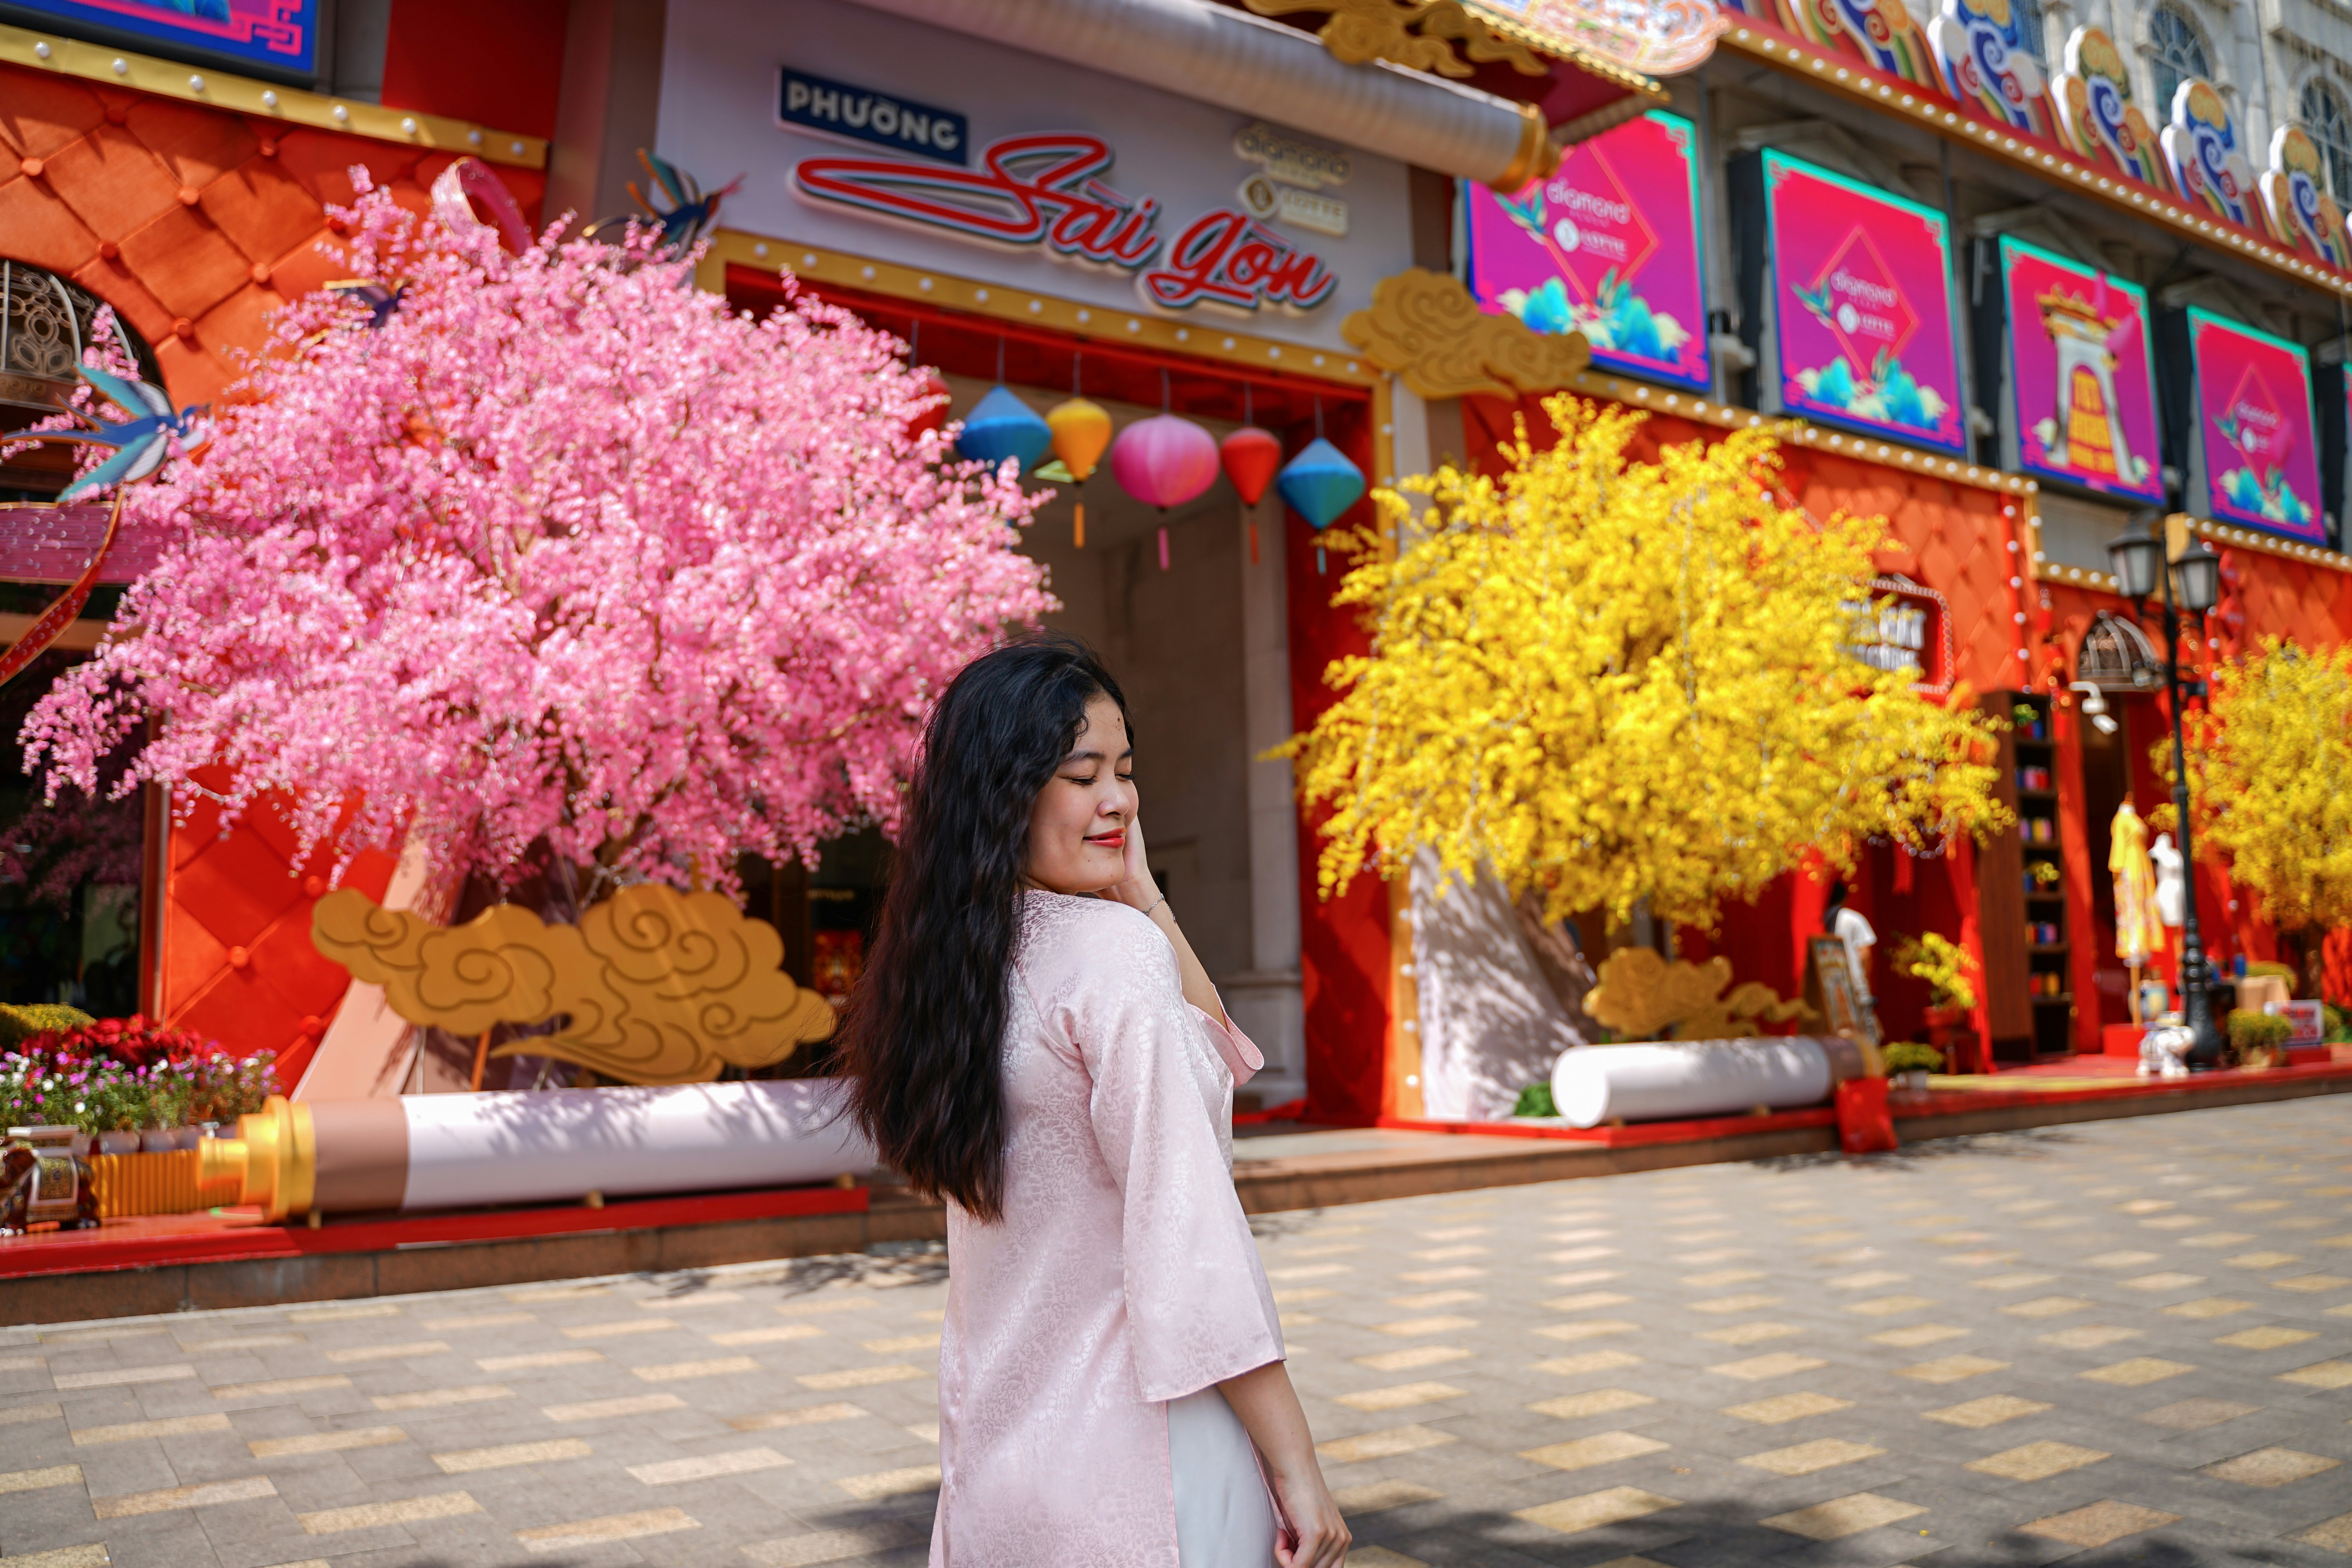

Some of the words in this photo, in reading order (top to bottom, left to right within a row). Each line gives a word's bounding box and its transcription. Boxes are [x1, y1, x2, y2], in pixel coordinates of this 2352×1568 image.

[796, 134, 1157, 260] Sài
[1546, 177, 1630, 225] diamond
[1580, 228, 1628, 256] LOTTE
